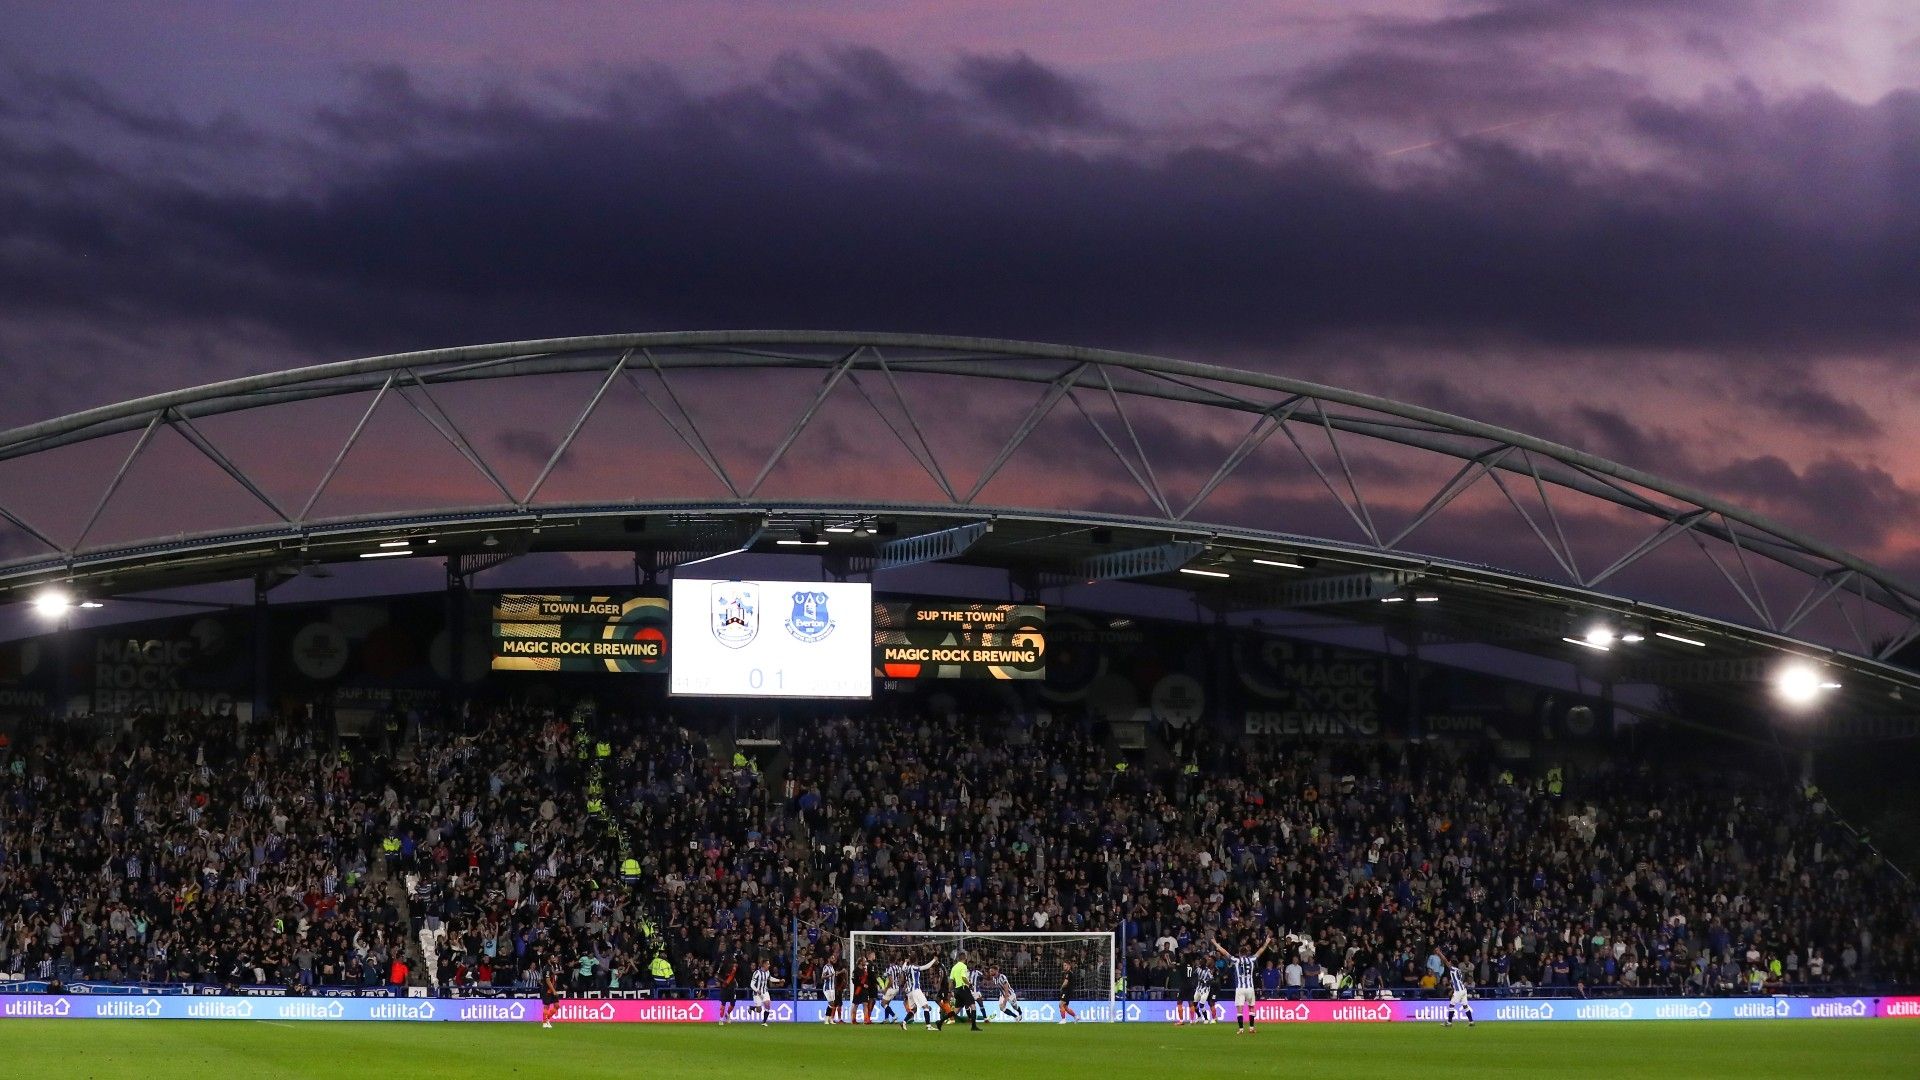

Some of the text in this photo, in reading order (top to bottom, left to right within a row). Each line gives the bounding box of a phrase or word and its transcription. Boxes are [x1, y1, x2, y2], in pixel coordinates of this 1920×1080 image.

[542, 602, 620, 615] TOWN LAGER
[916, 610, 1005, 622] SUP THE TOWN!
[795, 619, 824, 627] Everton
[96, 638, 193, 664] MAGIC
[503, 640, 658, 656] MAGIC ROCK BREWING
[885, 648, 1035, 663] MAGIC ROCK BREWING
[96, 664, 181, 689] ROCK
[749, 668, 764, 689] 0
[775, 668, 784, 690] 1
[1283, 663, 1377, 687] MAGIC
[1295, 687, 1377, 710] ROCK
[1244, 711, 1379, 735] BREWING
[1424, 715, 1482, 731] TOWN
[5, 1000, 53, 1016] utilita
[96, 1001, 145, 1016] utilita
[188, 1002, 236, 1017] utilita
[279, 1003, 327, 1018] utilita
[370, 1003, 418, 1018] utilita
[461, 1004, 509, 1019] utilita
[640, 1004, 688, 1020] utilita
[1080, 1006, 1123, 1020] utilia
[1332, 1005, 1376, 1020] utilita
[1496, 1005, 1539, 1019] utilita
[1576, 1004, 1620, 1019] utilita
[1656, 1003, 1698, 1018] utilita
[1733, 1003, 1775, 1017] utilita
[1811, 1002, 1853, 1017] utilita
